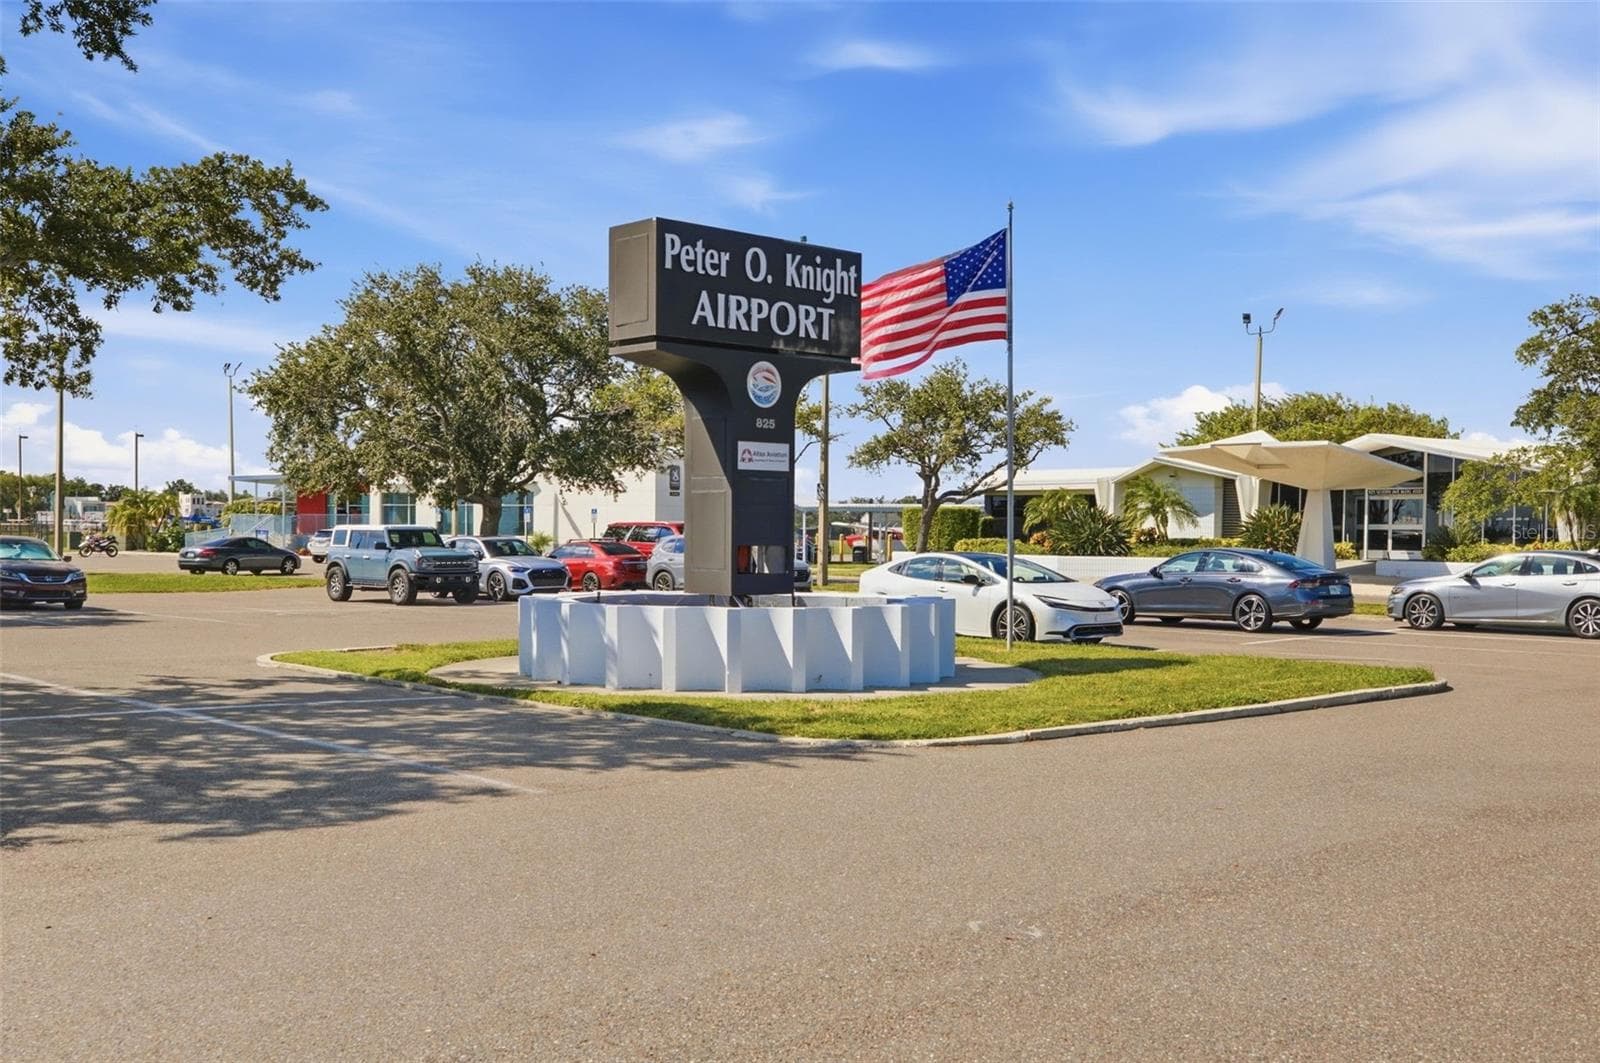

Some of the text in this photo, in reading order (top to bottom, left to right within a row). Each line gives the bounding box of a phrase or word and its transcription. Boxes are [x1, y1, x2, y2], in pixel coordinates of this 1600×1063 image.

[664, 232, 858, 304] Peter O. Knight
[691, 290, 836, 341] AIRPORT
[755, 417, 776, 429] 825
